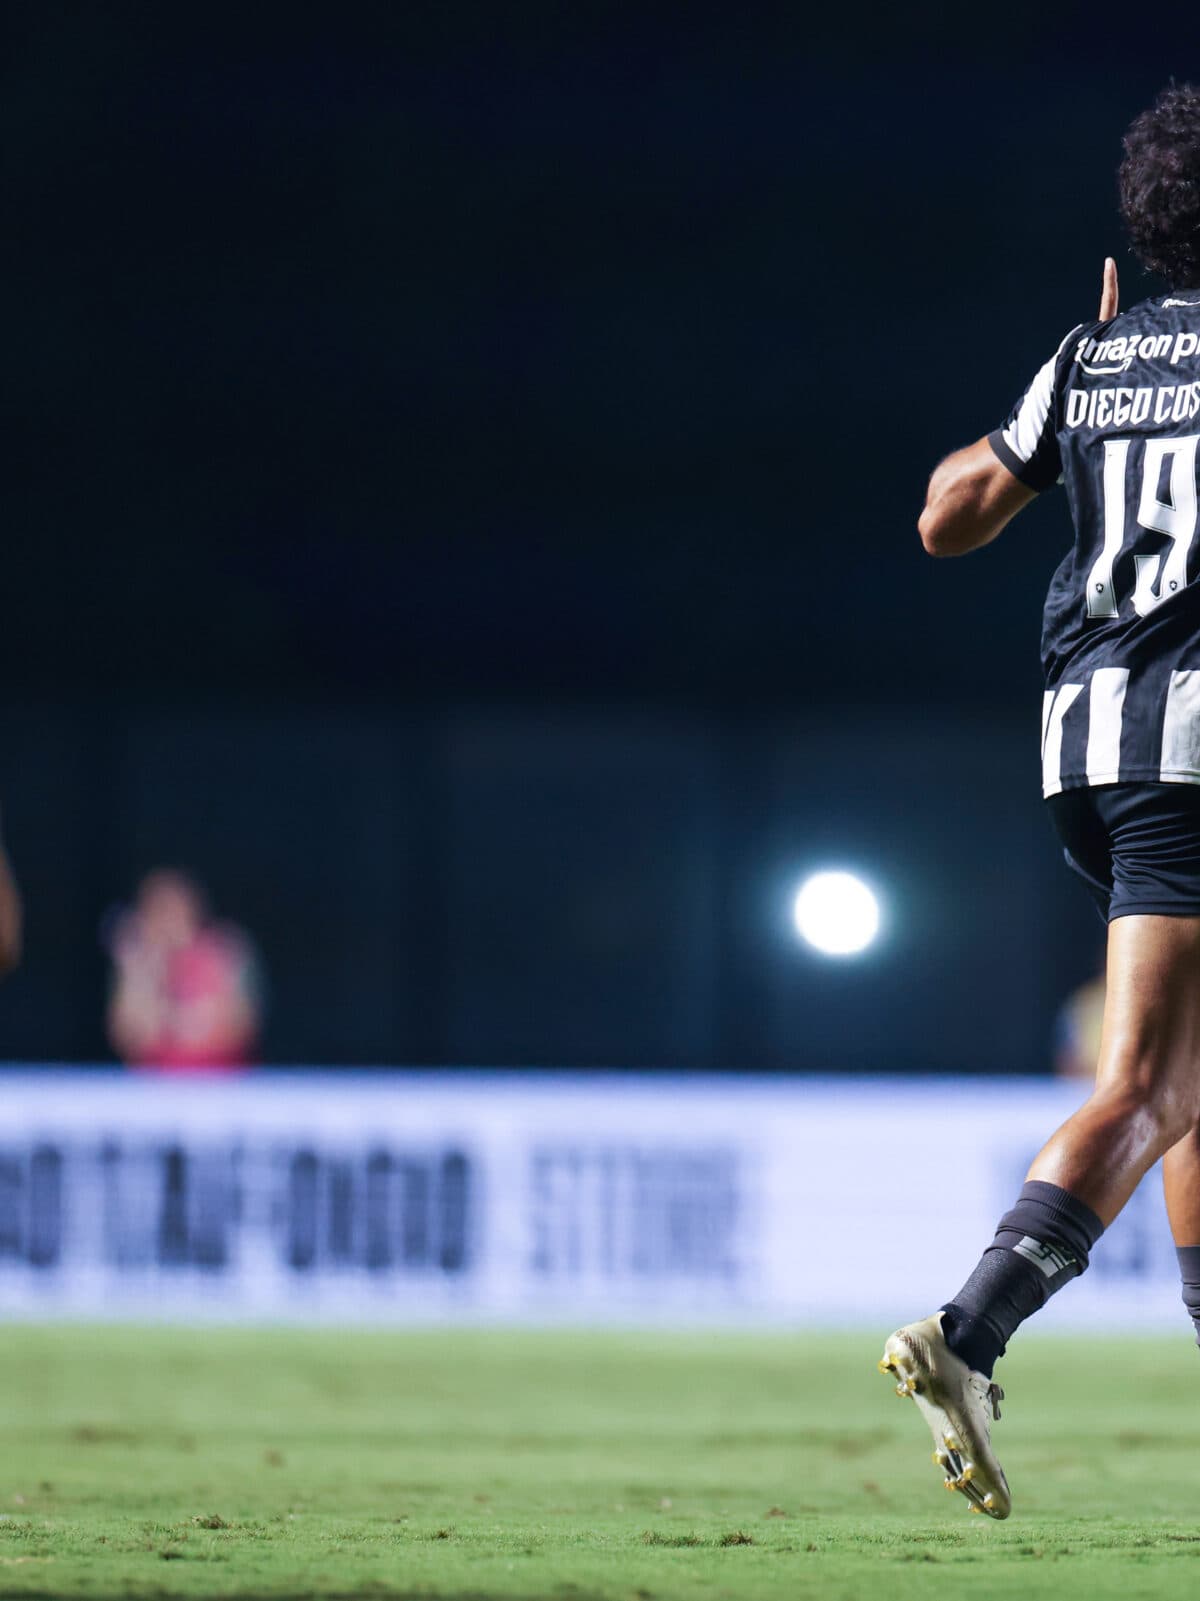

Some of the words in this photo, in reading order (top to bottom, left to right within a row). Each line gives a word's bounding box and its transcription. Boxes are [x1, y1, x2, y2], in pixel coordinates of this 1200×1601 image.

[1074, 334, 1173, 367] amazon
[1066, 387, 1153, 429] DIEGO
[1087, 434, 1200, 619] 19
